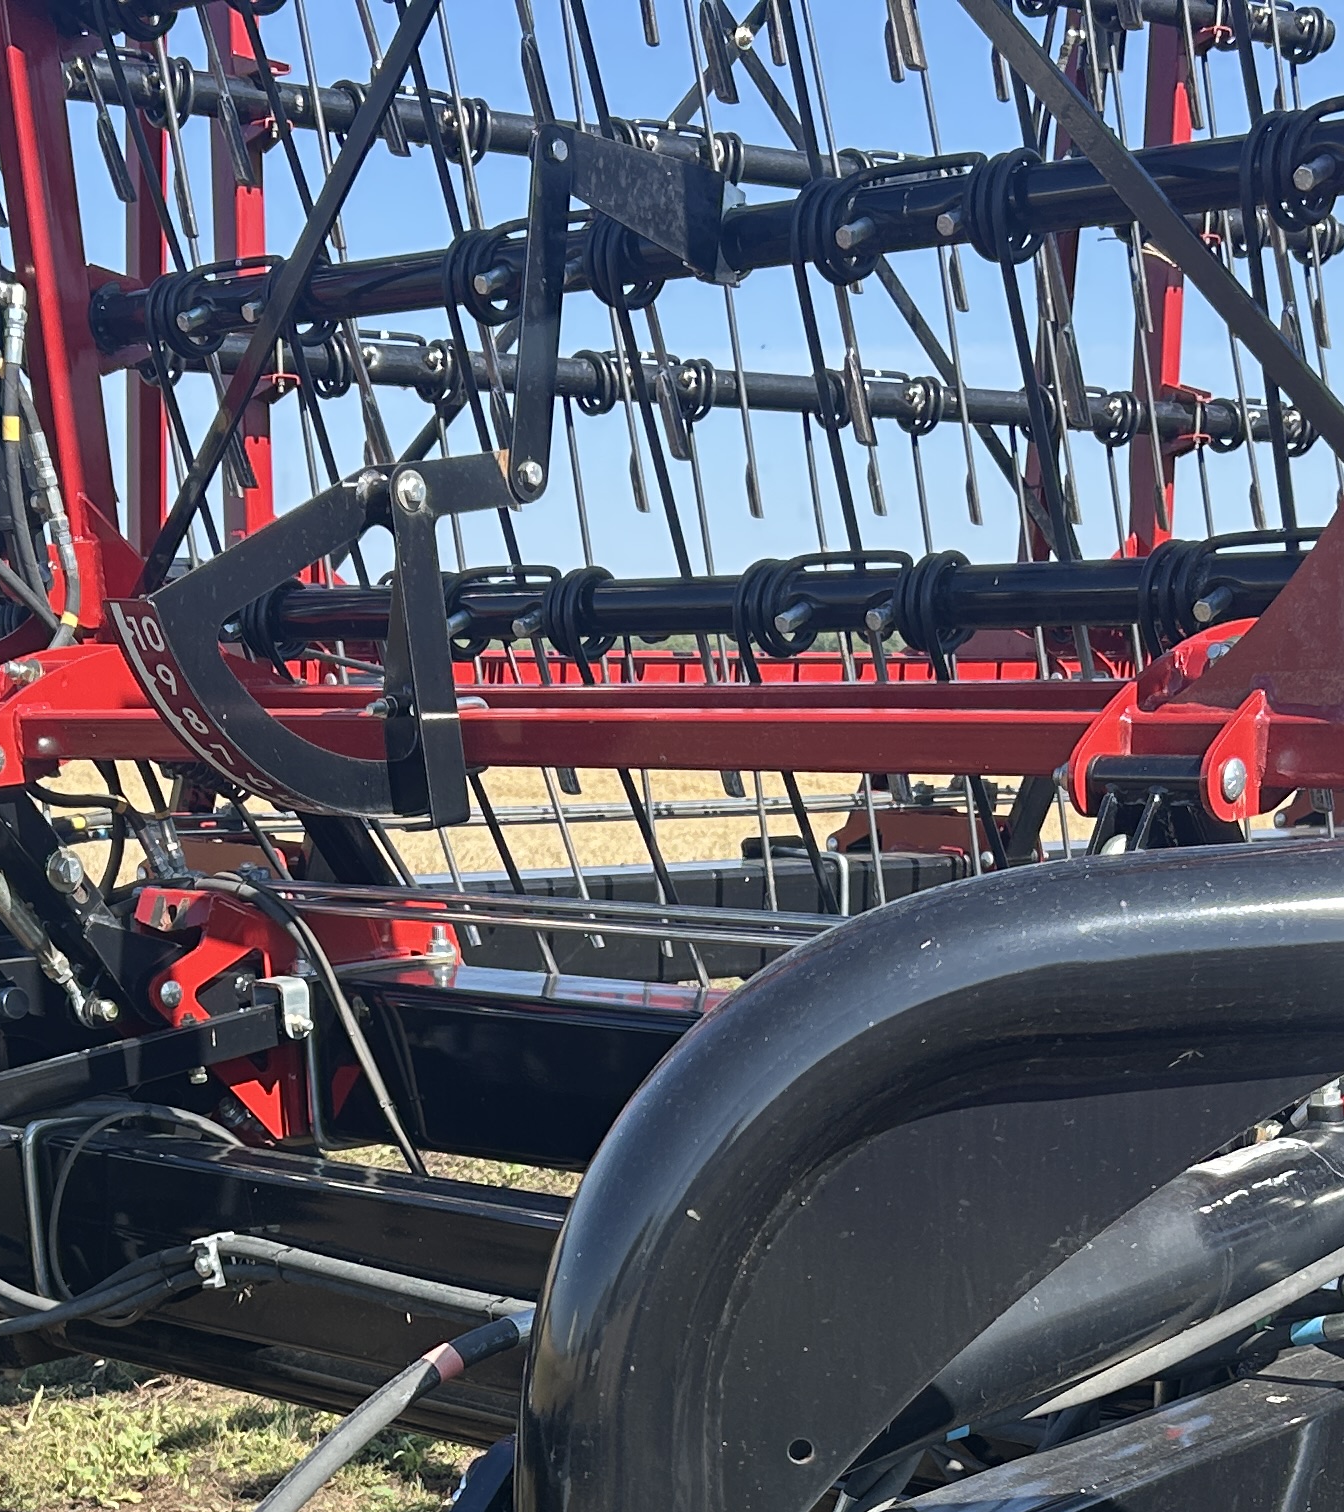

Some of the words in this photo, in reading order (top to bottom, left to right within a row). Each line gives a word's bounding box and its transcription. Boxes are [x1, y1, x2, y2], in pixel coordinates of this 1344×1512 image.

[126, 616, 165, 652] 10
[156, 664, 177, 695] 9
[182, 707, 209, 734] 8
[208, 743, 234, 765] 7
[246, 772, 273, 789] 6
